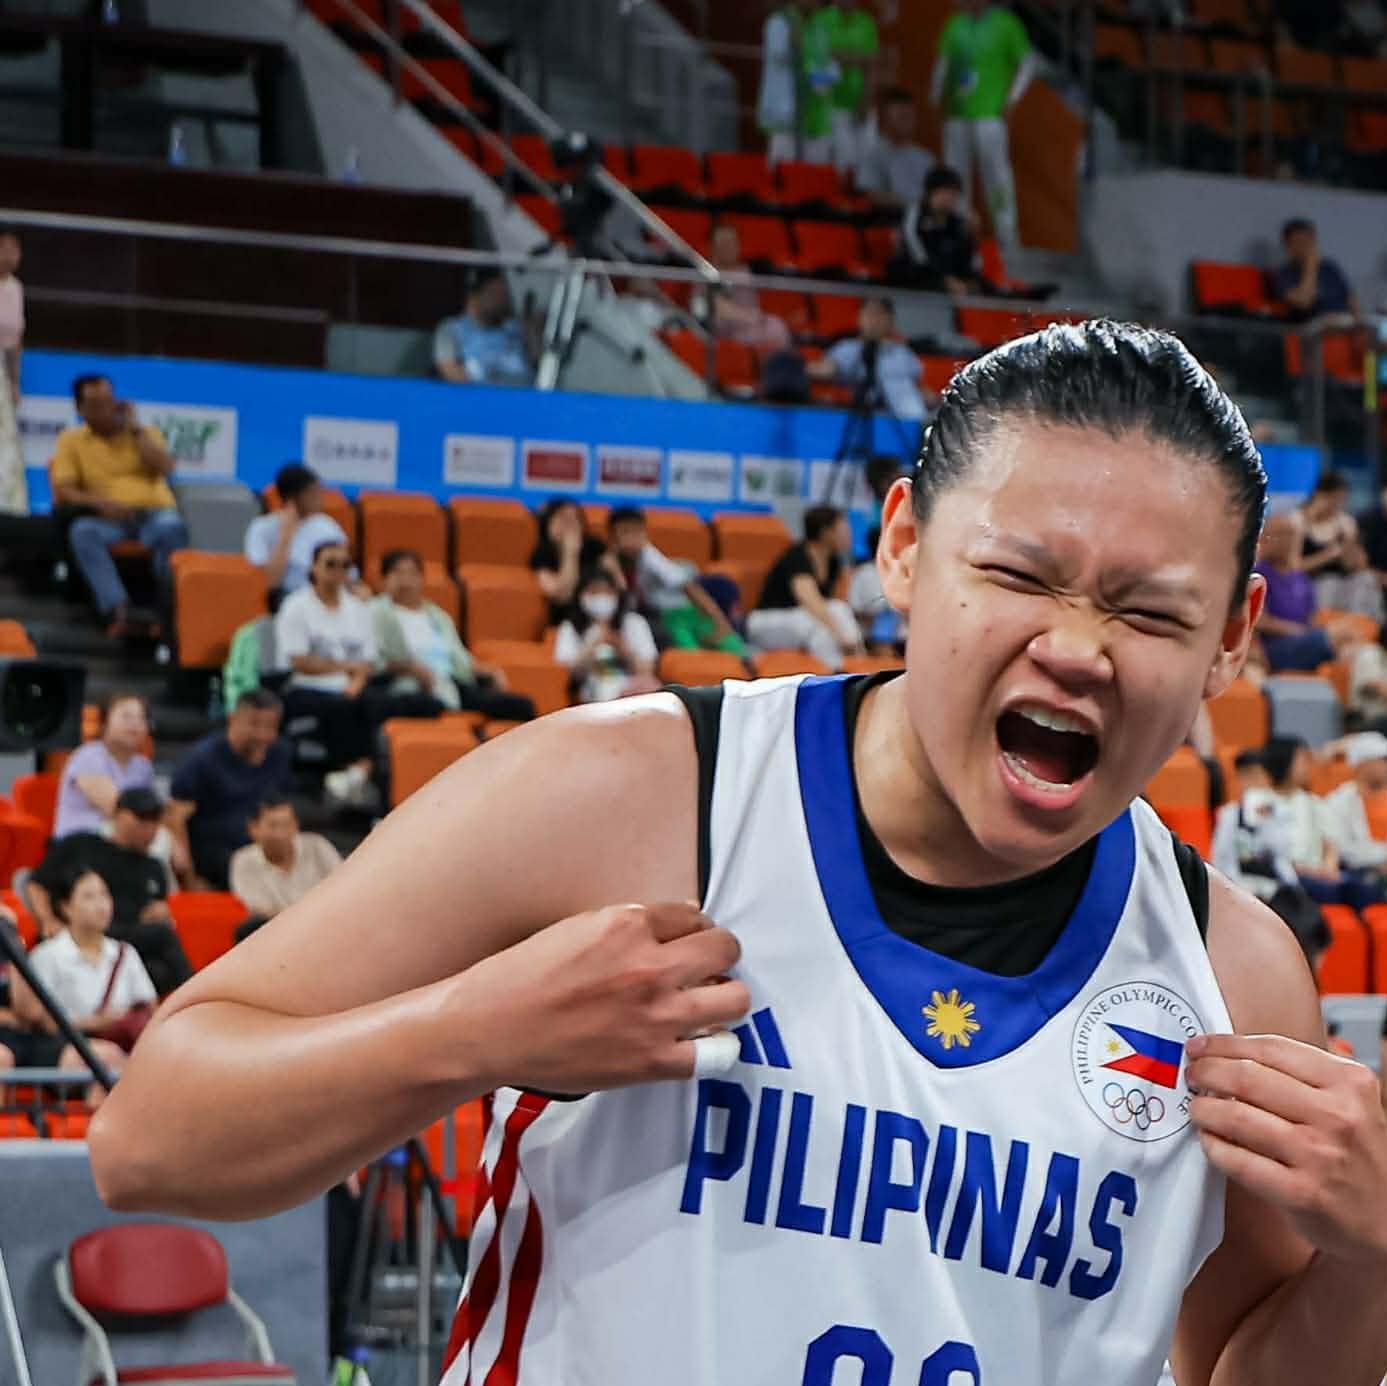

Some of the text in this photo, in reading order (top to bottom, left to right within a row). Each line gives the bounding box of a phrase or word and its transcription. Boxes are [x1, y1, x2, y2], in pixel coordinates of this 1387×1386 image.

[1076, 1000, 1111, 1085] PHILIPPINE
[1110, 989, 1181, 1017] OLYMPIC
[679, 1078, 1137, 1301] PILIPINAS
